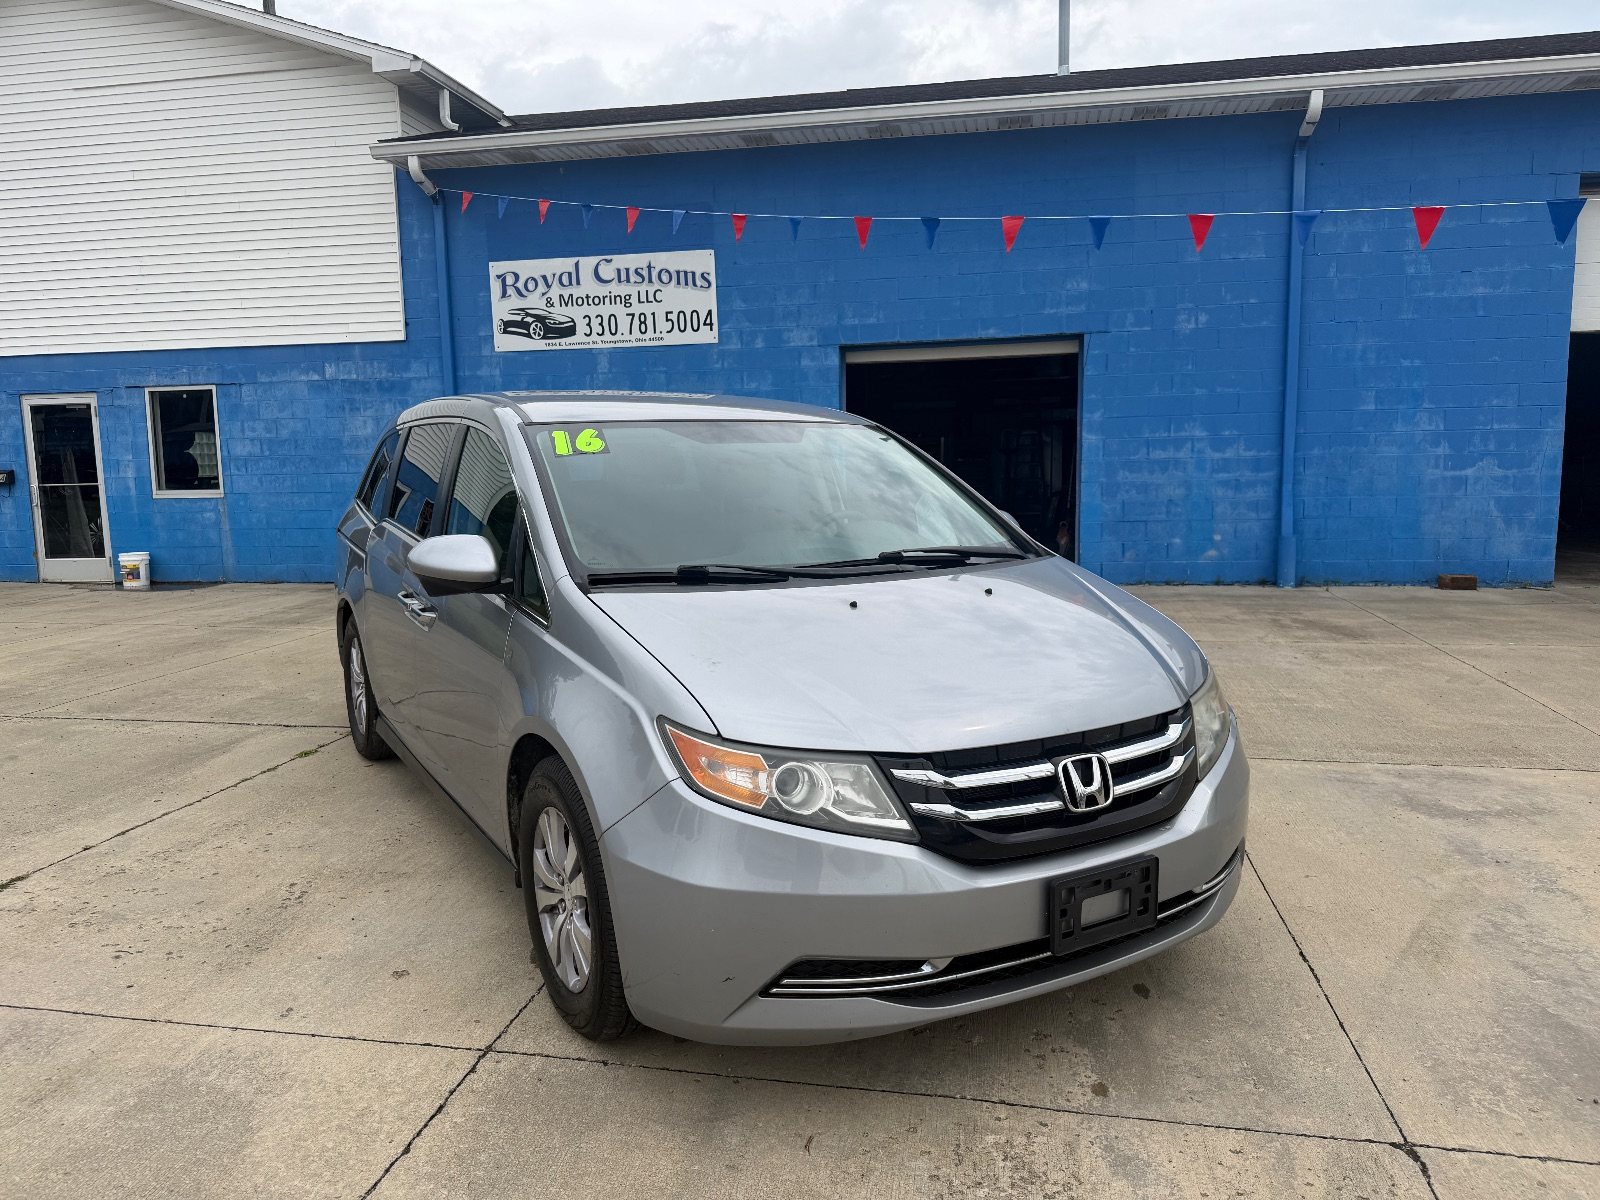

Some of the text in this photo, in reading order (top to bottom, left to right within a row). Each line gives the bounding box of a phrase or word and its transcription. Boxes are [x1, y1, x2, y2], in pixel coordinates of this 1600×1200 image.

[496, 258, 713, 300] Royal Customs
[545, 289, 663, 308] & Motoring LLC
[582, 309, 715, 337] 330.781.5004
[551, 428, 606, 456] 16
